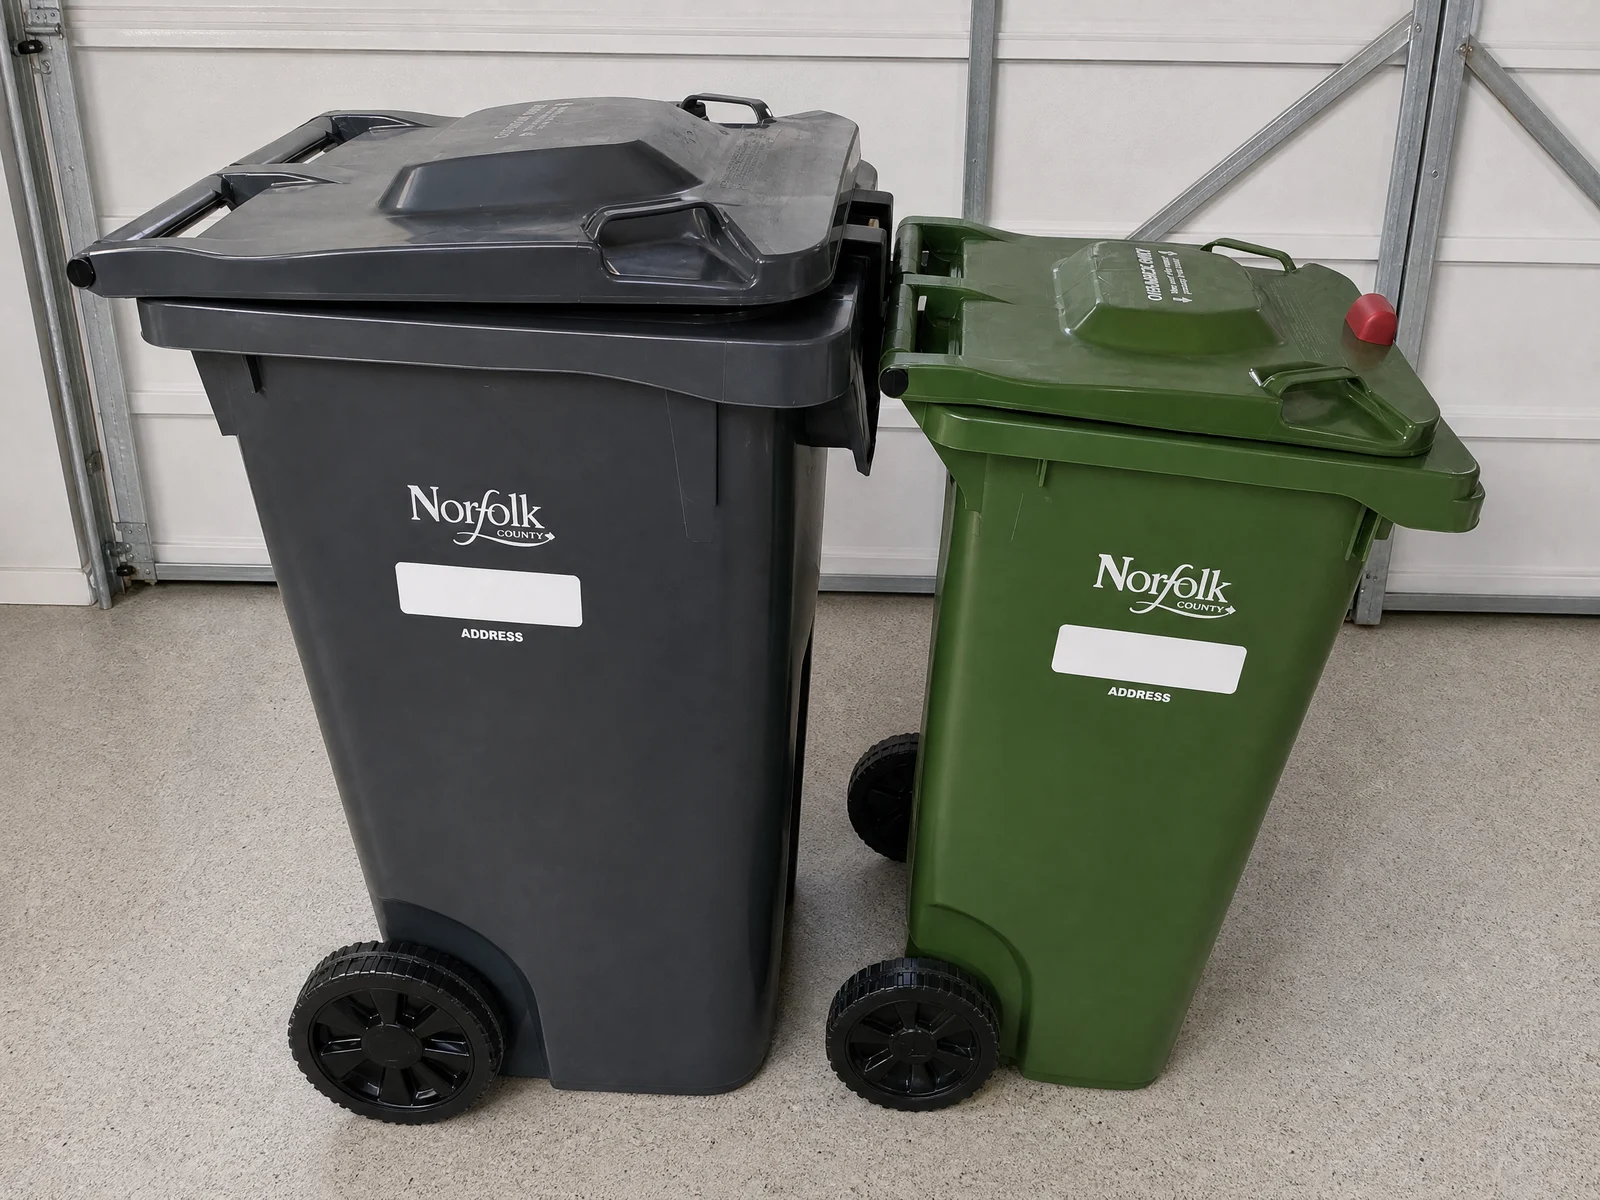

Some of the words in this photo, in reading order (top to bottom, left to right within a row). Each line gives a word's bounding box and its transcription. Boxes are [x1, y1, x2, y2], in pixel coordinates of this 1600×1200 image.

[407, 484, 545, 546] Norfolk
[496, 529, 544, 540] COUNTY
[1093, 553, 1232, 614] Norfolk
[1176, 600, 1225, 613] COUNTY
[461, 628, 524, 643] ADDRESS
[1107, 686, 1171, 703] ADDRESS
